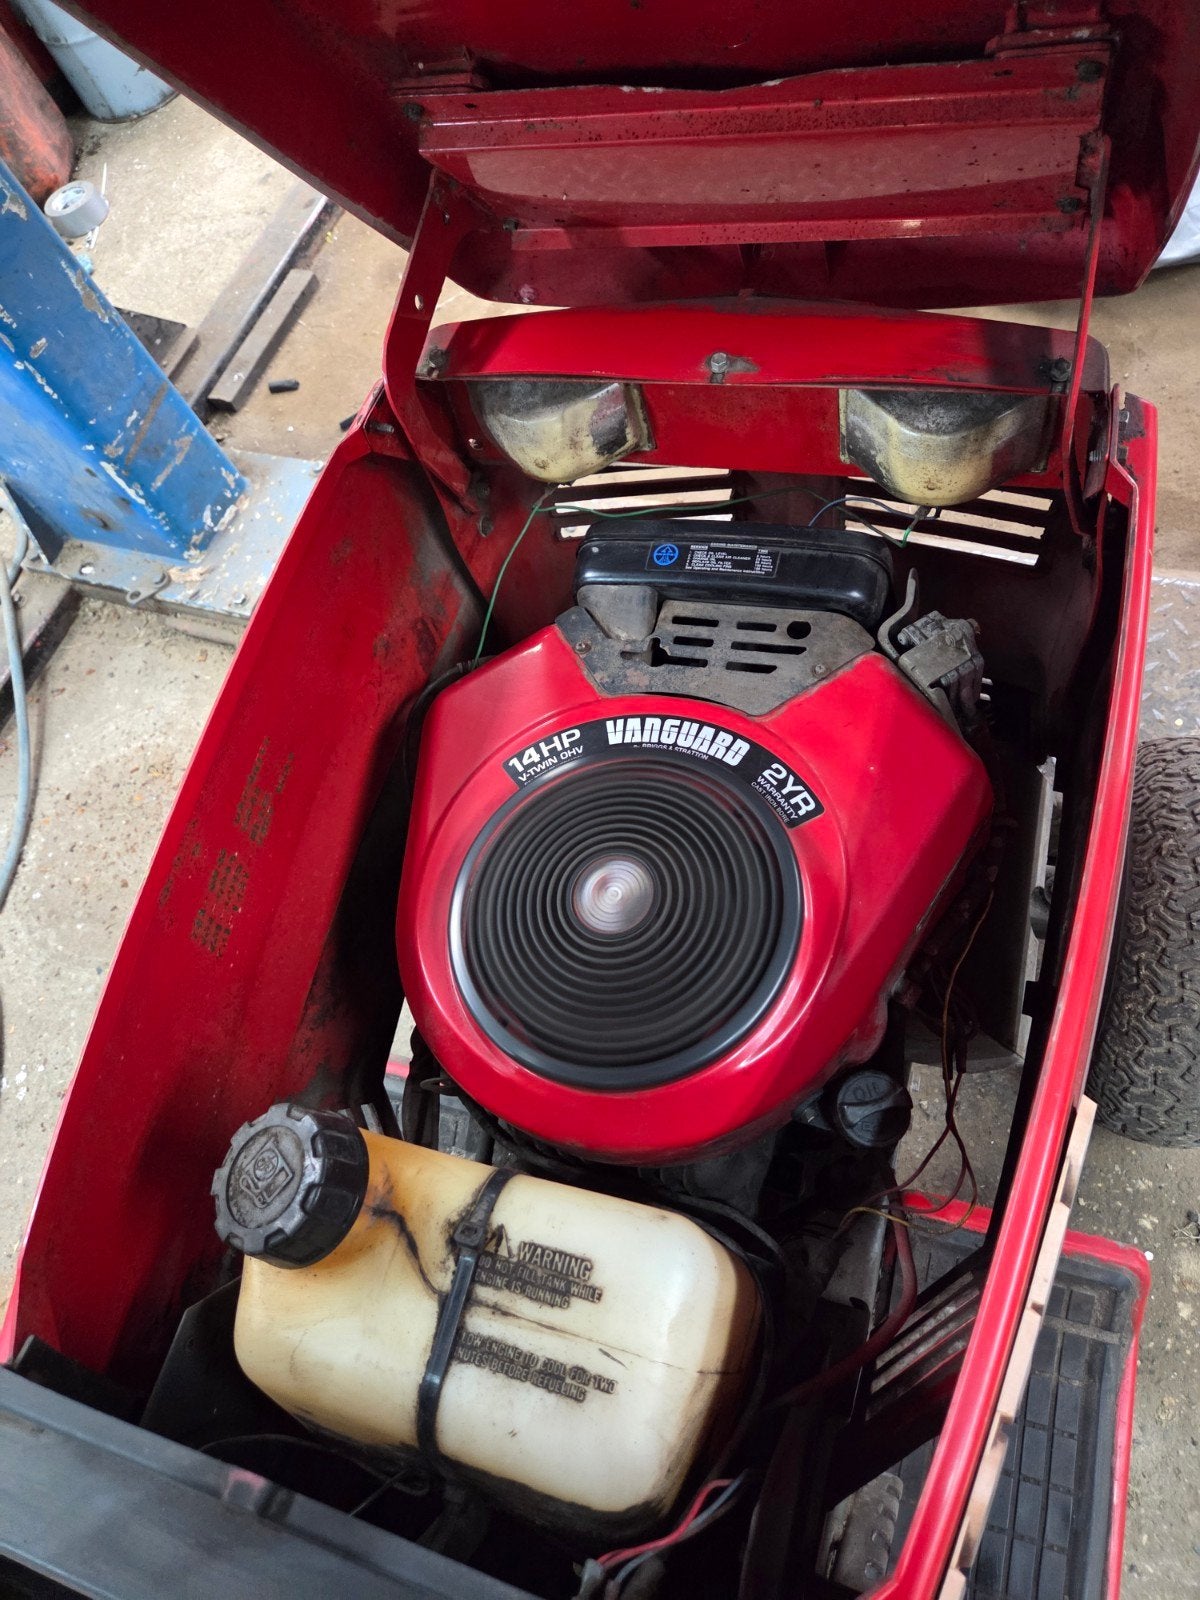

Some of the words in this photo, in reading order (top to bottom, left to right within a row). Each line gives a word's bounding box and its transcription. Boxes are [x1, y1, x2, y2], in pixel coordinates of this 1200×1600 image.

[606, 717, 750, 766] VANGUARD
[674, 746, 708, 760] STRATTON
[518, 756, 558, 782] V-TWIN
[560, 745, 583, 760] OHV
[751, 782, 766, 795] CAST
[765, 794, 778, 808] IRON
[776, 808, 790, 823] BORE
[757, 776, 798, 819] WARRANTY
[762, 763, 816, 816] 2YR
[853, 1081, 881, 1100] OIL
[495, 1260, 514, 1274] NOT
[517, 1266, 536, 1283] FILL
[541, 1273, 566, 1290] TANK
[570, 1283, 602, 1303] WHILE
[518, 1242, 593, 1281] WARNING
[475, 1269, 509, 1290] ENGINE
[511, 1280, 522, 1293] IS
[525, 1284, 570, 1308] RUNNING
[486, 1340, 521, 1363] ENGINE
[523, 1352, 539, 1367] TO
[540, 1357, 567, 1377] COOL
[569, 1366, 591, 1386] FOR
[592, 1374, 618, 1395] TWO
[491, 1358, 528, 1382] BEFORE
[530, 1371, 587, 1401] REFUELING
